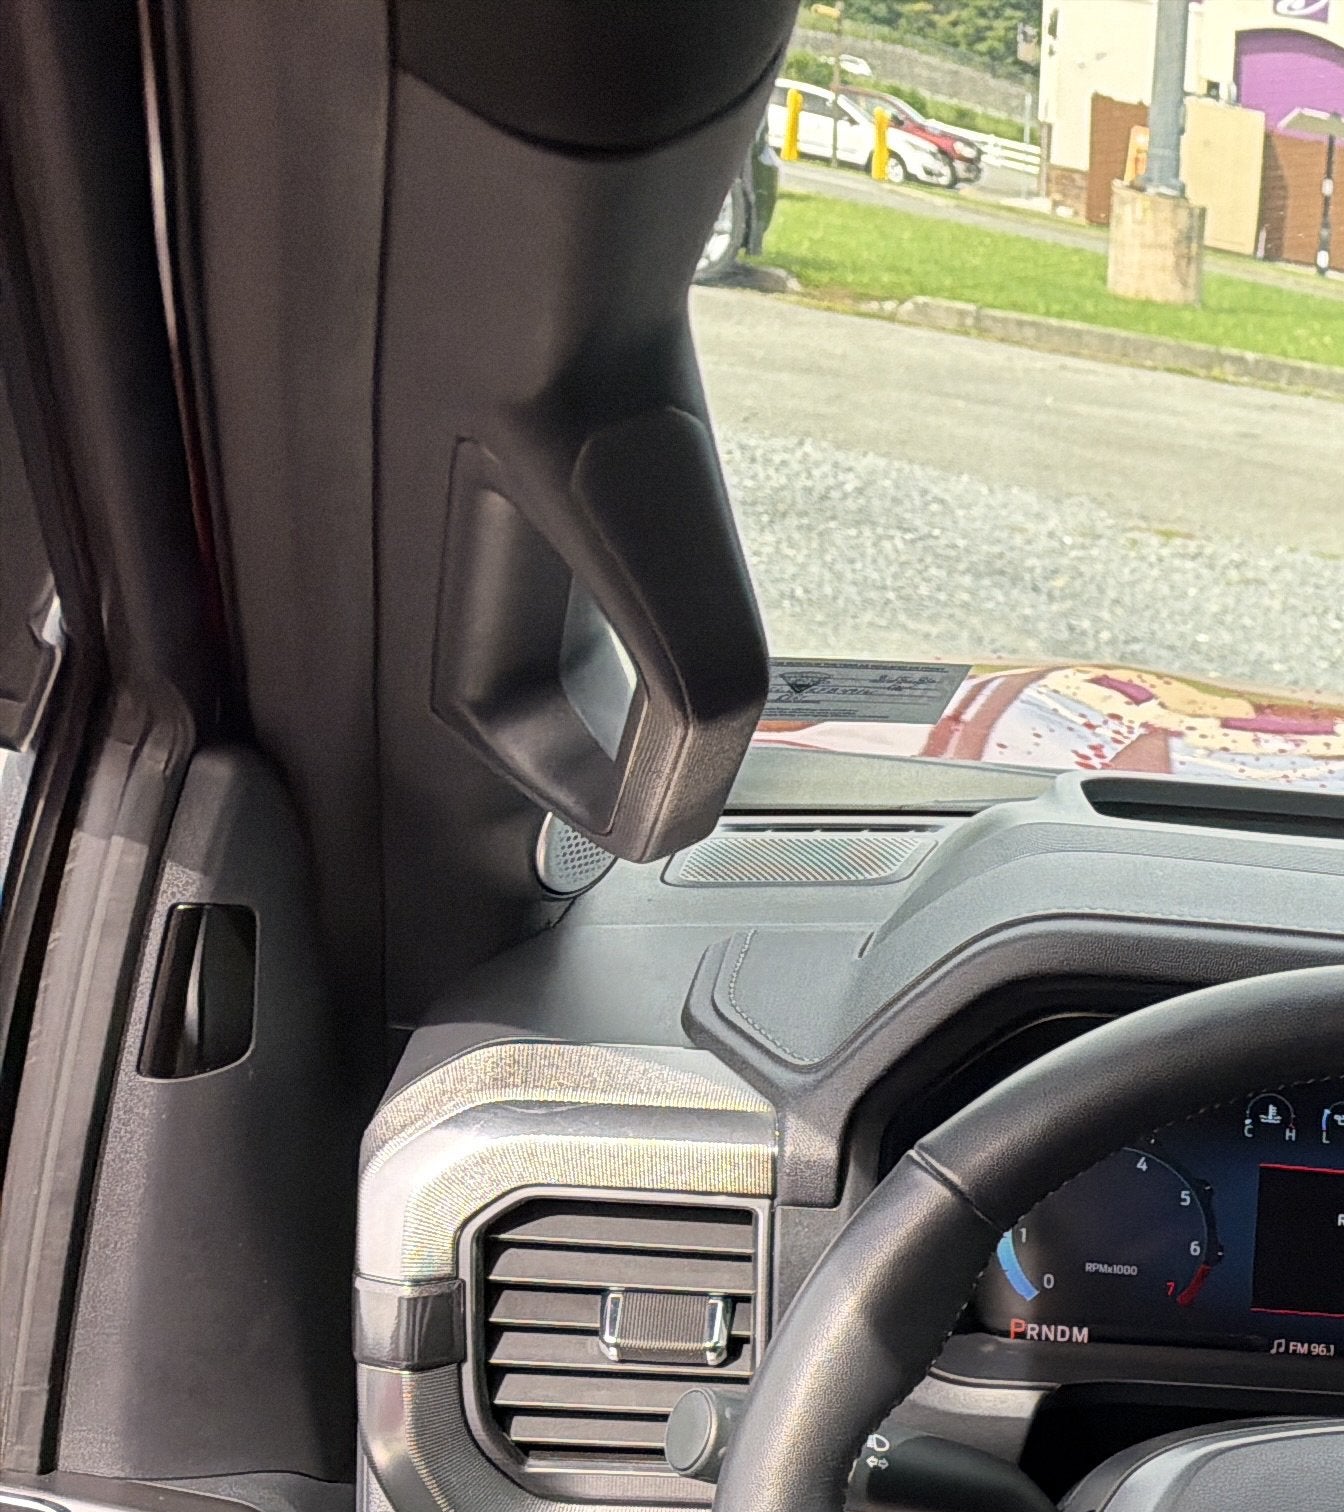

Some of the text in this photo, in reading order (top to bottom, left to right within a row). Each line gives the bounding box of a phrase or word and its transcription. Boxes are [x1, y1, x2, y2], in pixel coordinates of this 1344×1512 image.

[1285, 1128, 1296, 1141] H
[1136, 1157, 1148, 1171] 4
[1180, 1190, 1191, 1206] 5
[1019, 1227, 1027, 1243] 1
[1190, 1241, 1201, 1256] 6
[1043, 1274, 1054, 1289] 0
[1166, 1281, 1175, 1296] 7
[1289, 1342, 1335, 1357] FM 96.1
